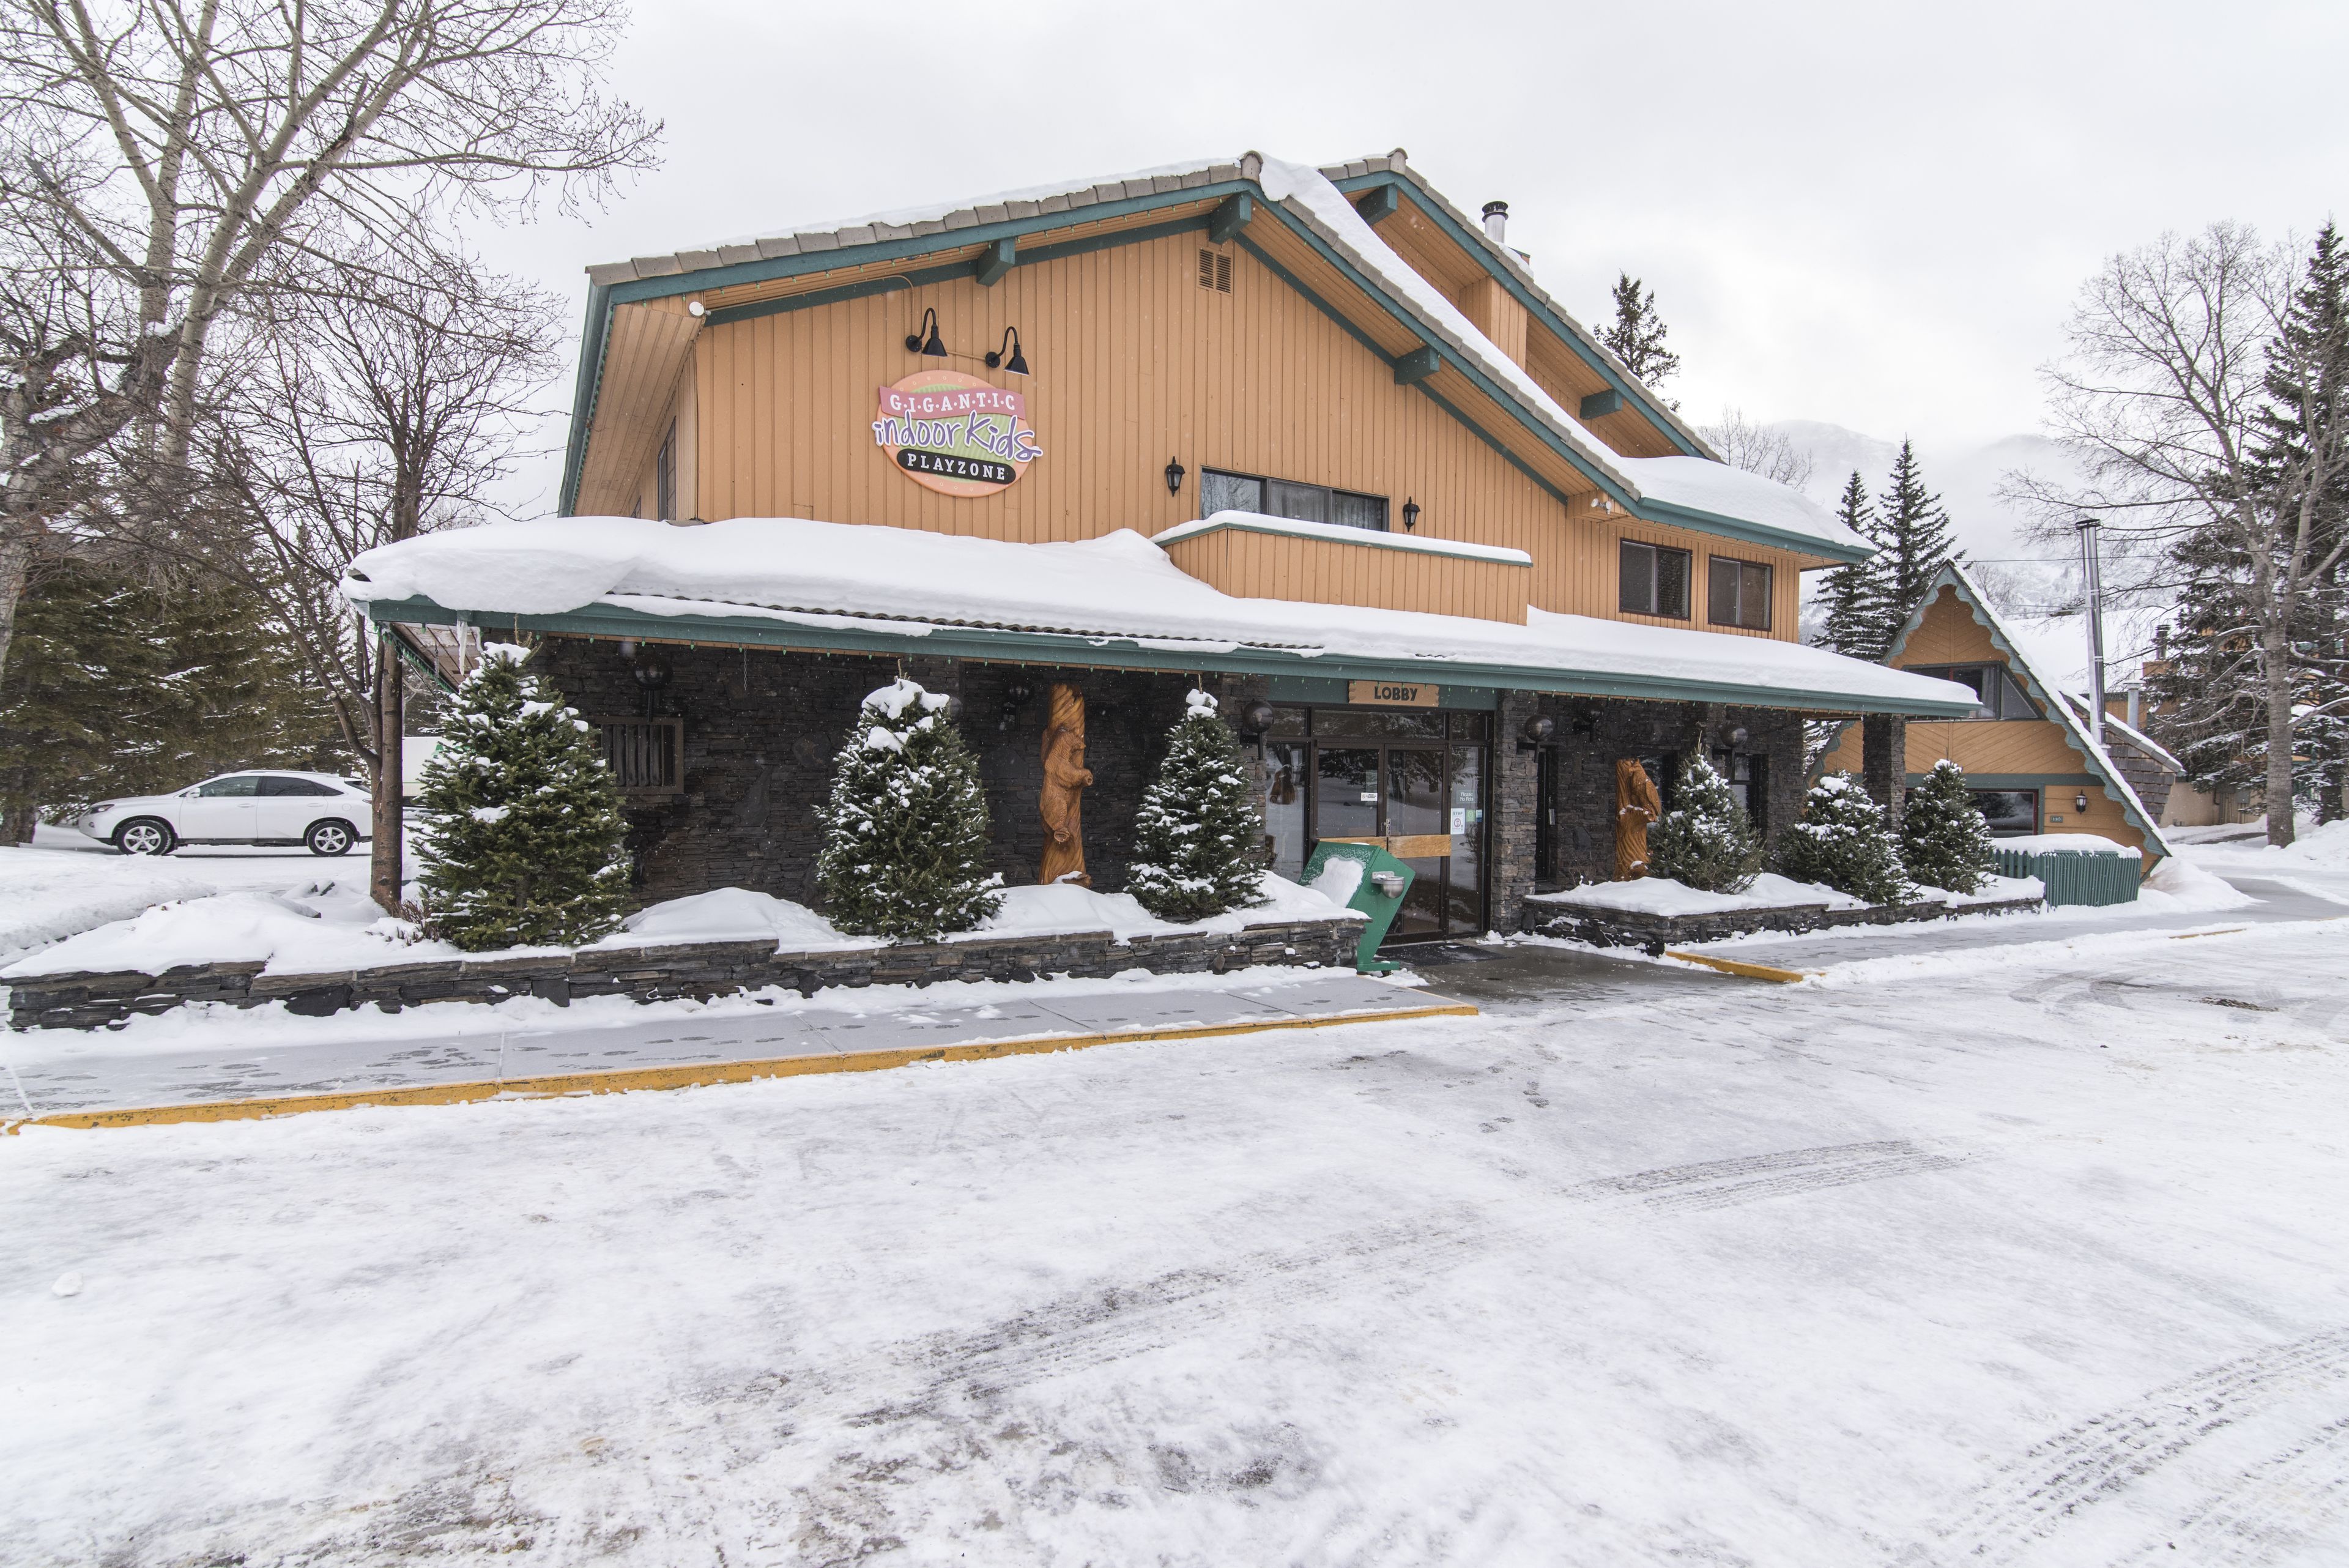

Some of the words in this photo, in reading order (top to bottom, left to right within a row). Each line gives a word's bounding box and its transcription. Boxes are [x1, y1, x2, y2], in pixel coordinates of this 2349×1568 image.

[873, 410, 962, 447] indoor
[965, 410, 1042, 461] Kids
[907, 453, 1005, 480] PLAYZONE
[1374, 686, 1418, 701] LOBBY
